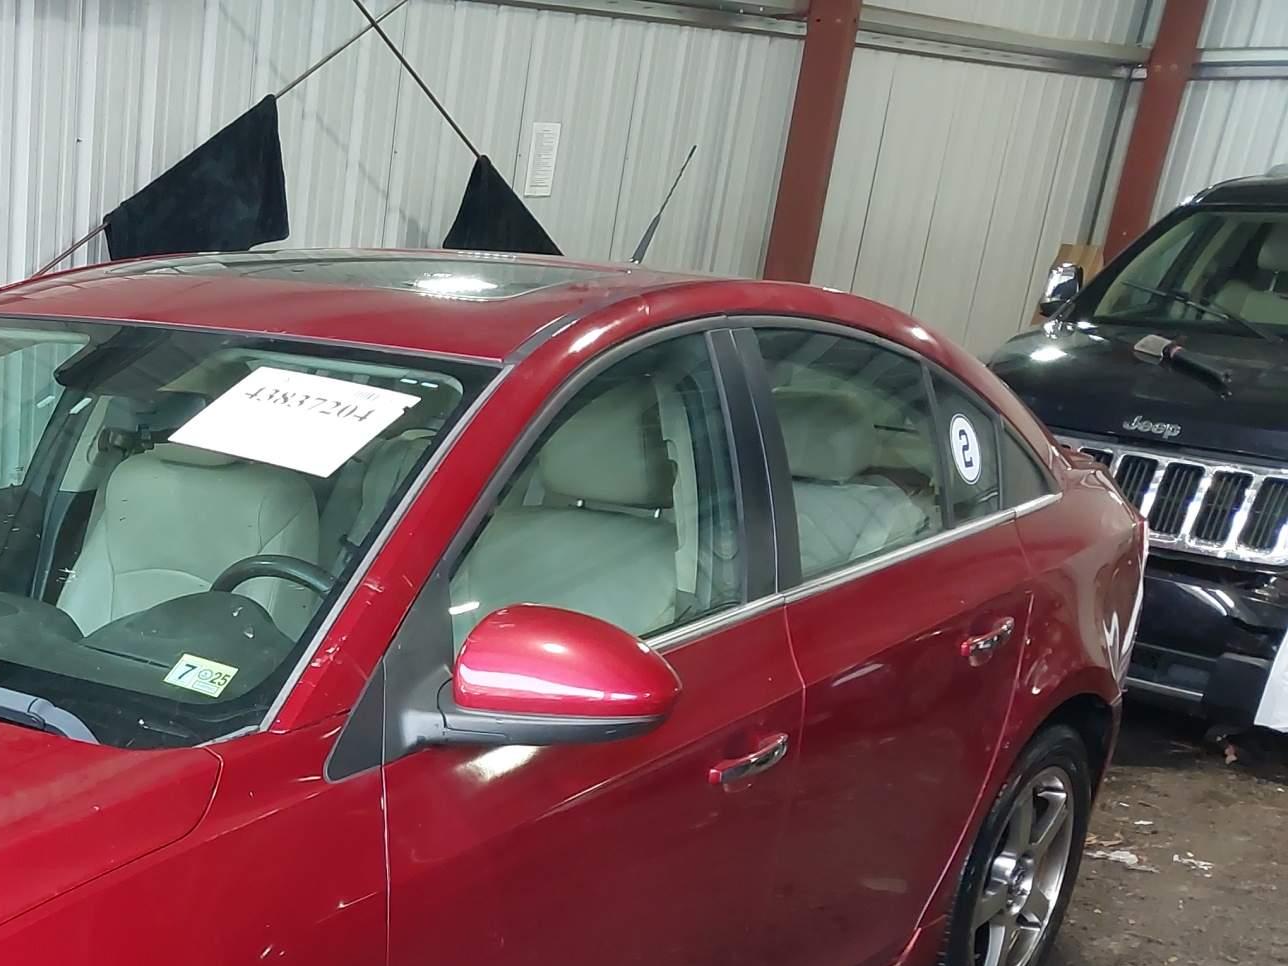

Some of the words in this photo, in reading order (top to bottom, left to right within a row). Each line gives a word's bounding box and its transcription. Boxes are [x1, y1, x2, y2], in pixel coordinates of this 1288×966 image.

[244, 386, 376, 422] 43837204
[1122, 415, 1182, 439] Jeep
[958, 428, 974, 468] 2
[178, 663, 198, 680] 7
[210, 671, 231, 687] 25
